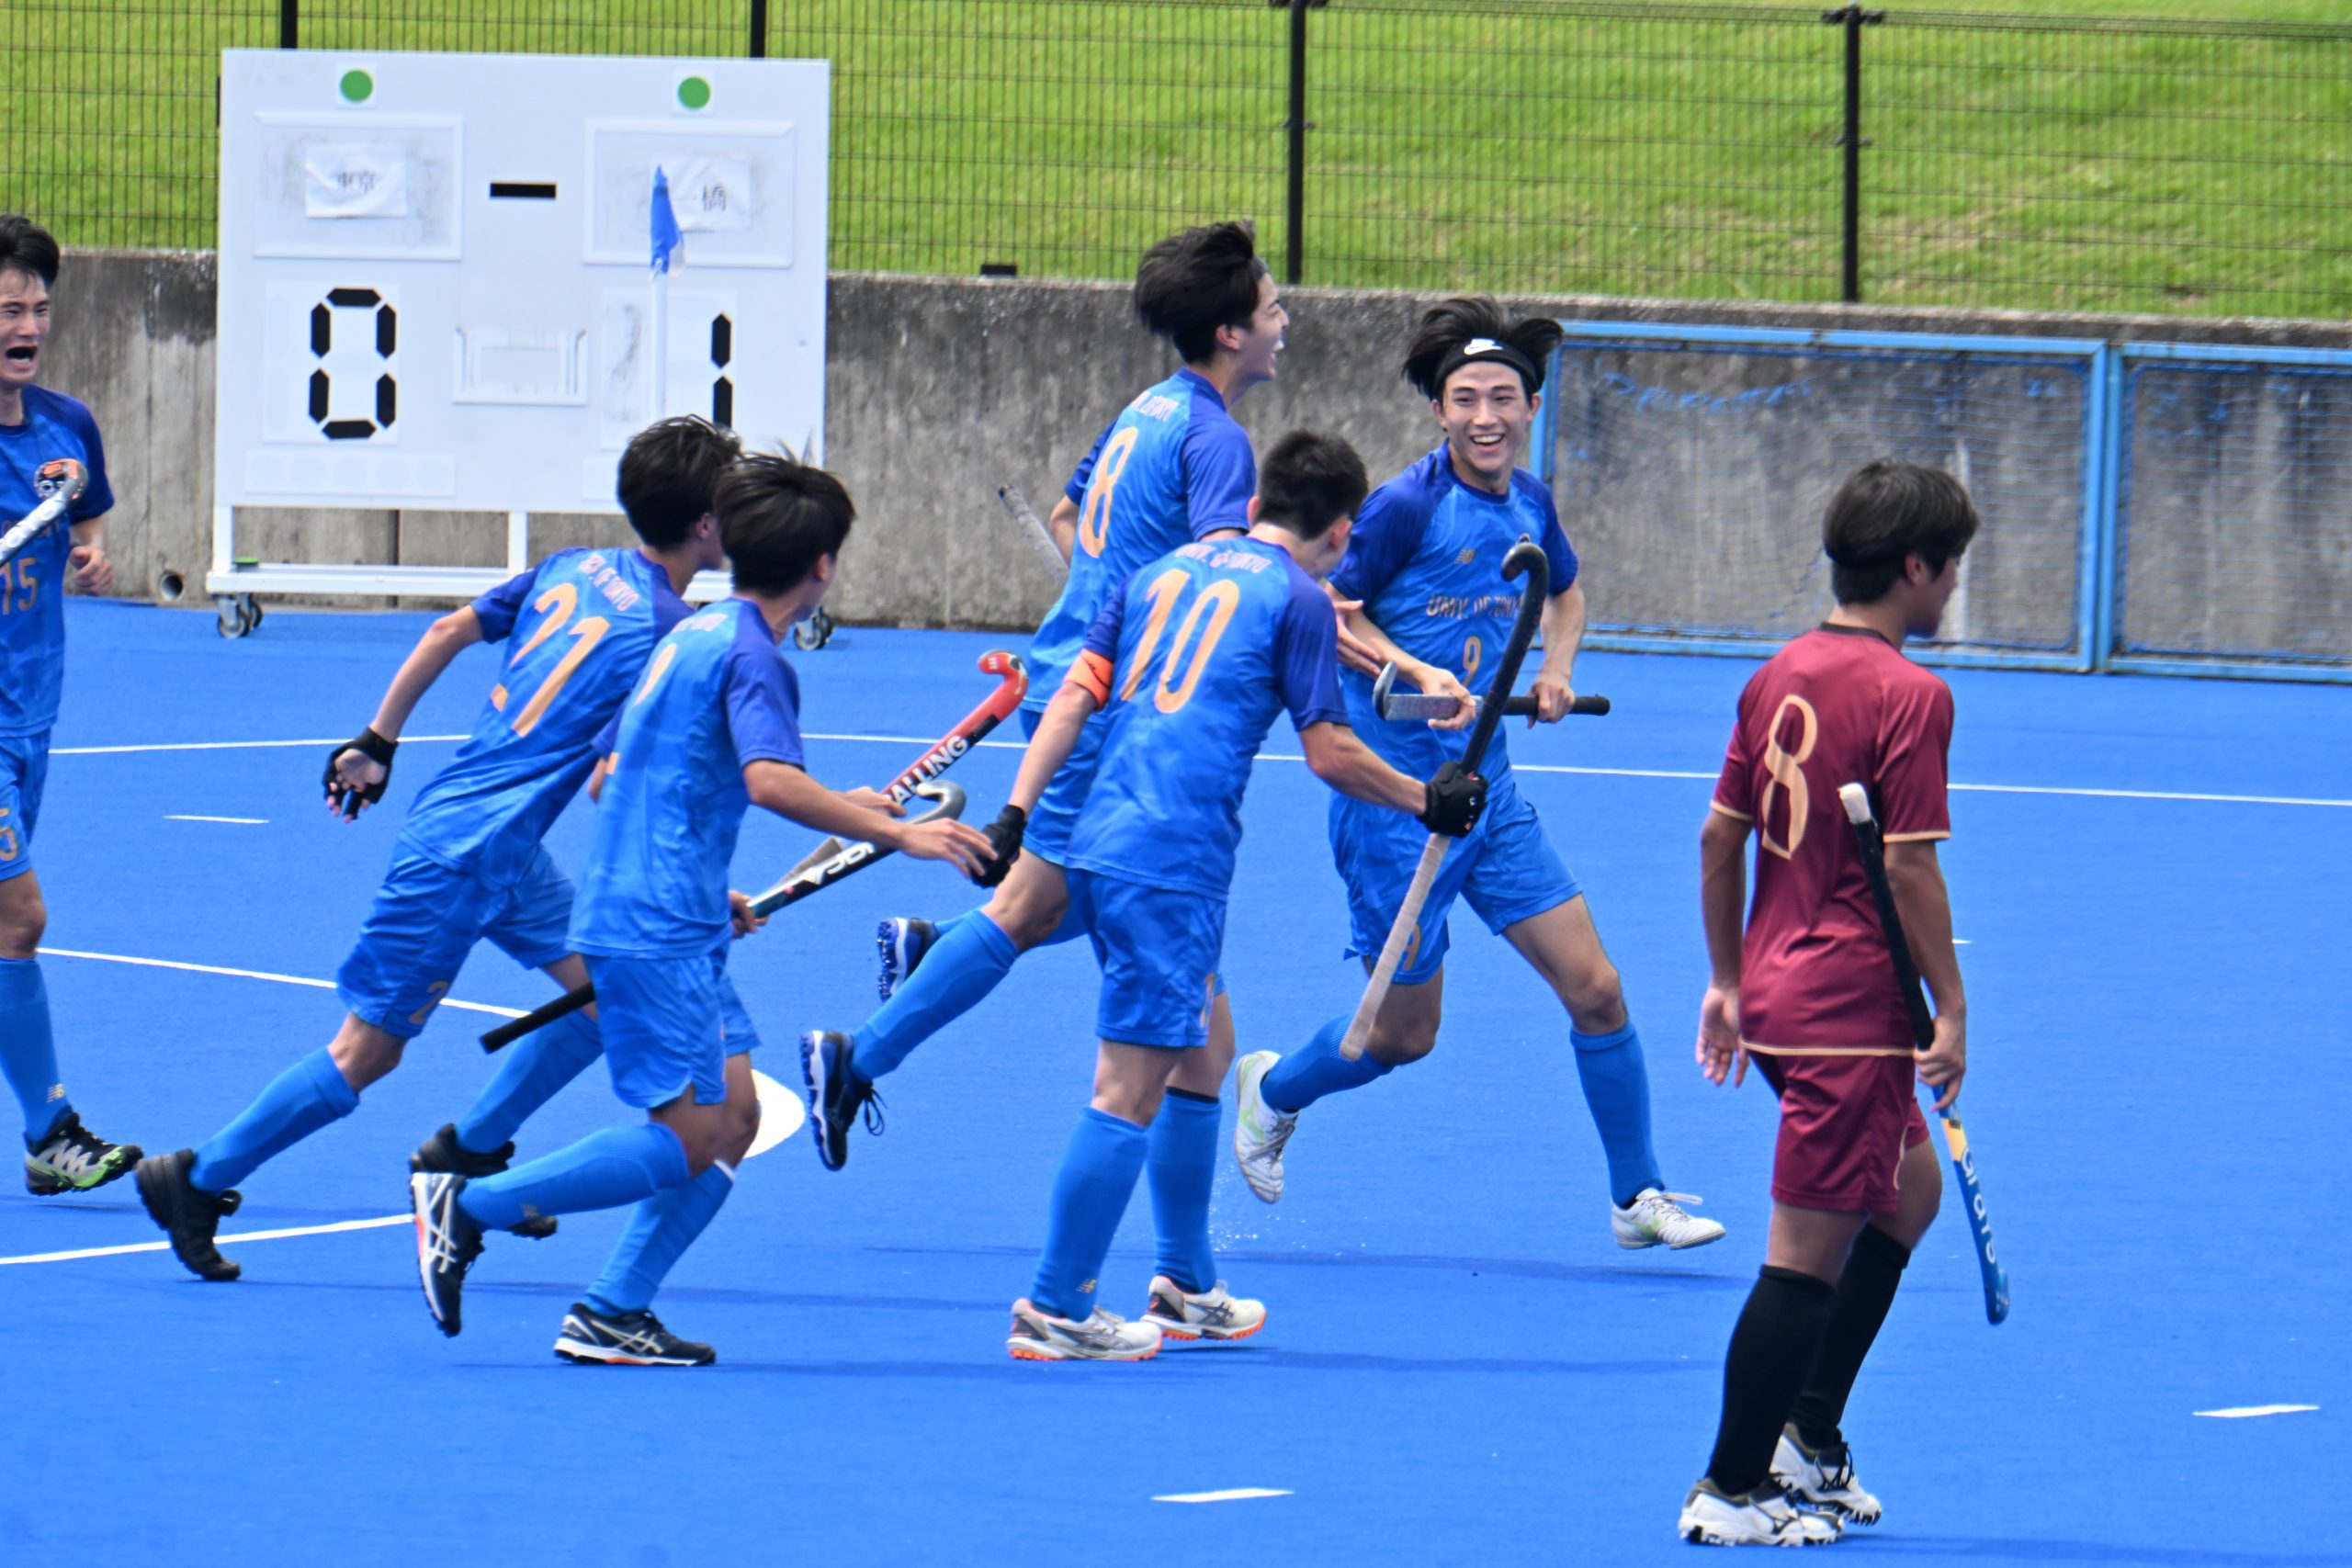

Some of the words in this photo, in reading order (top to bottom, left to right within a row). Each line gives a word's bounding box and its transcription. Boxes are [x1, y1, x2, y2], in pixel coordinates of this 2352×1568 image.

[309, 287, 397, 440] 0
[710, 312, 733, 428] 1
[1079, 426, 1139, 558] 8
[0, 557, 37, 615] 15
[1120, 569, 1239, 714] 10
[1462, 636, 1481, 688] 9
[883, 735, 969, 806] ALLING
[1762, 694, 1818, 860] 8
